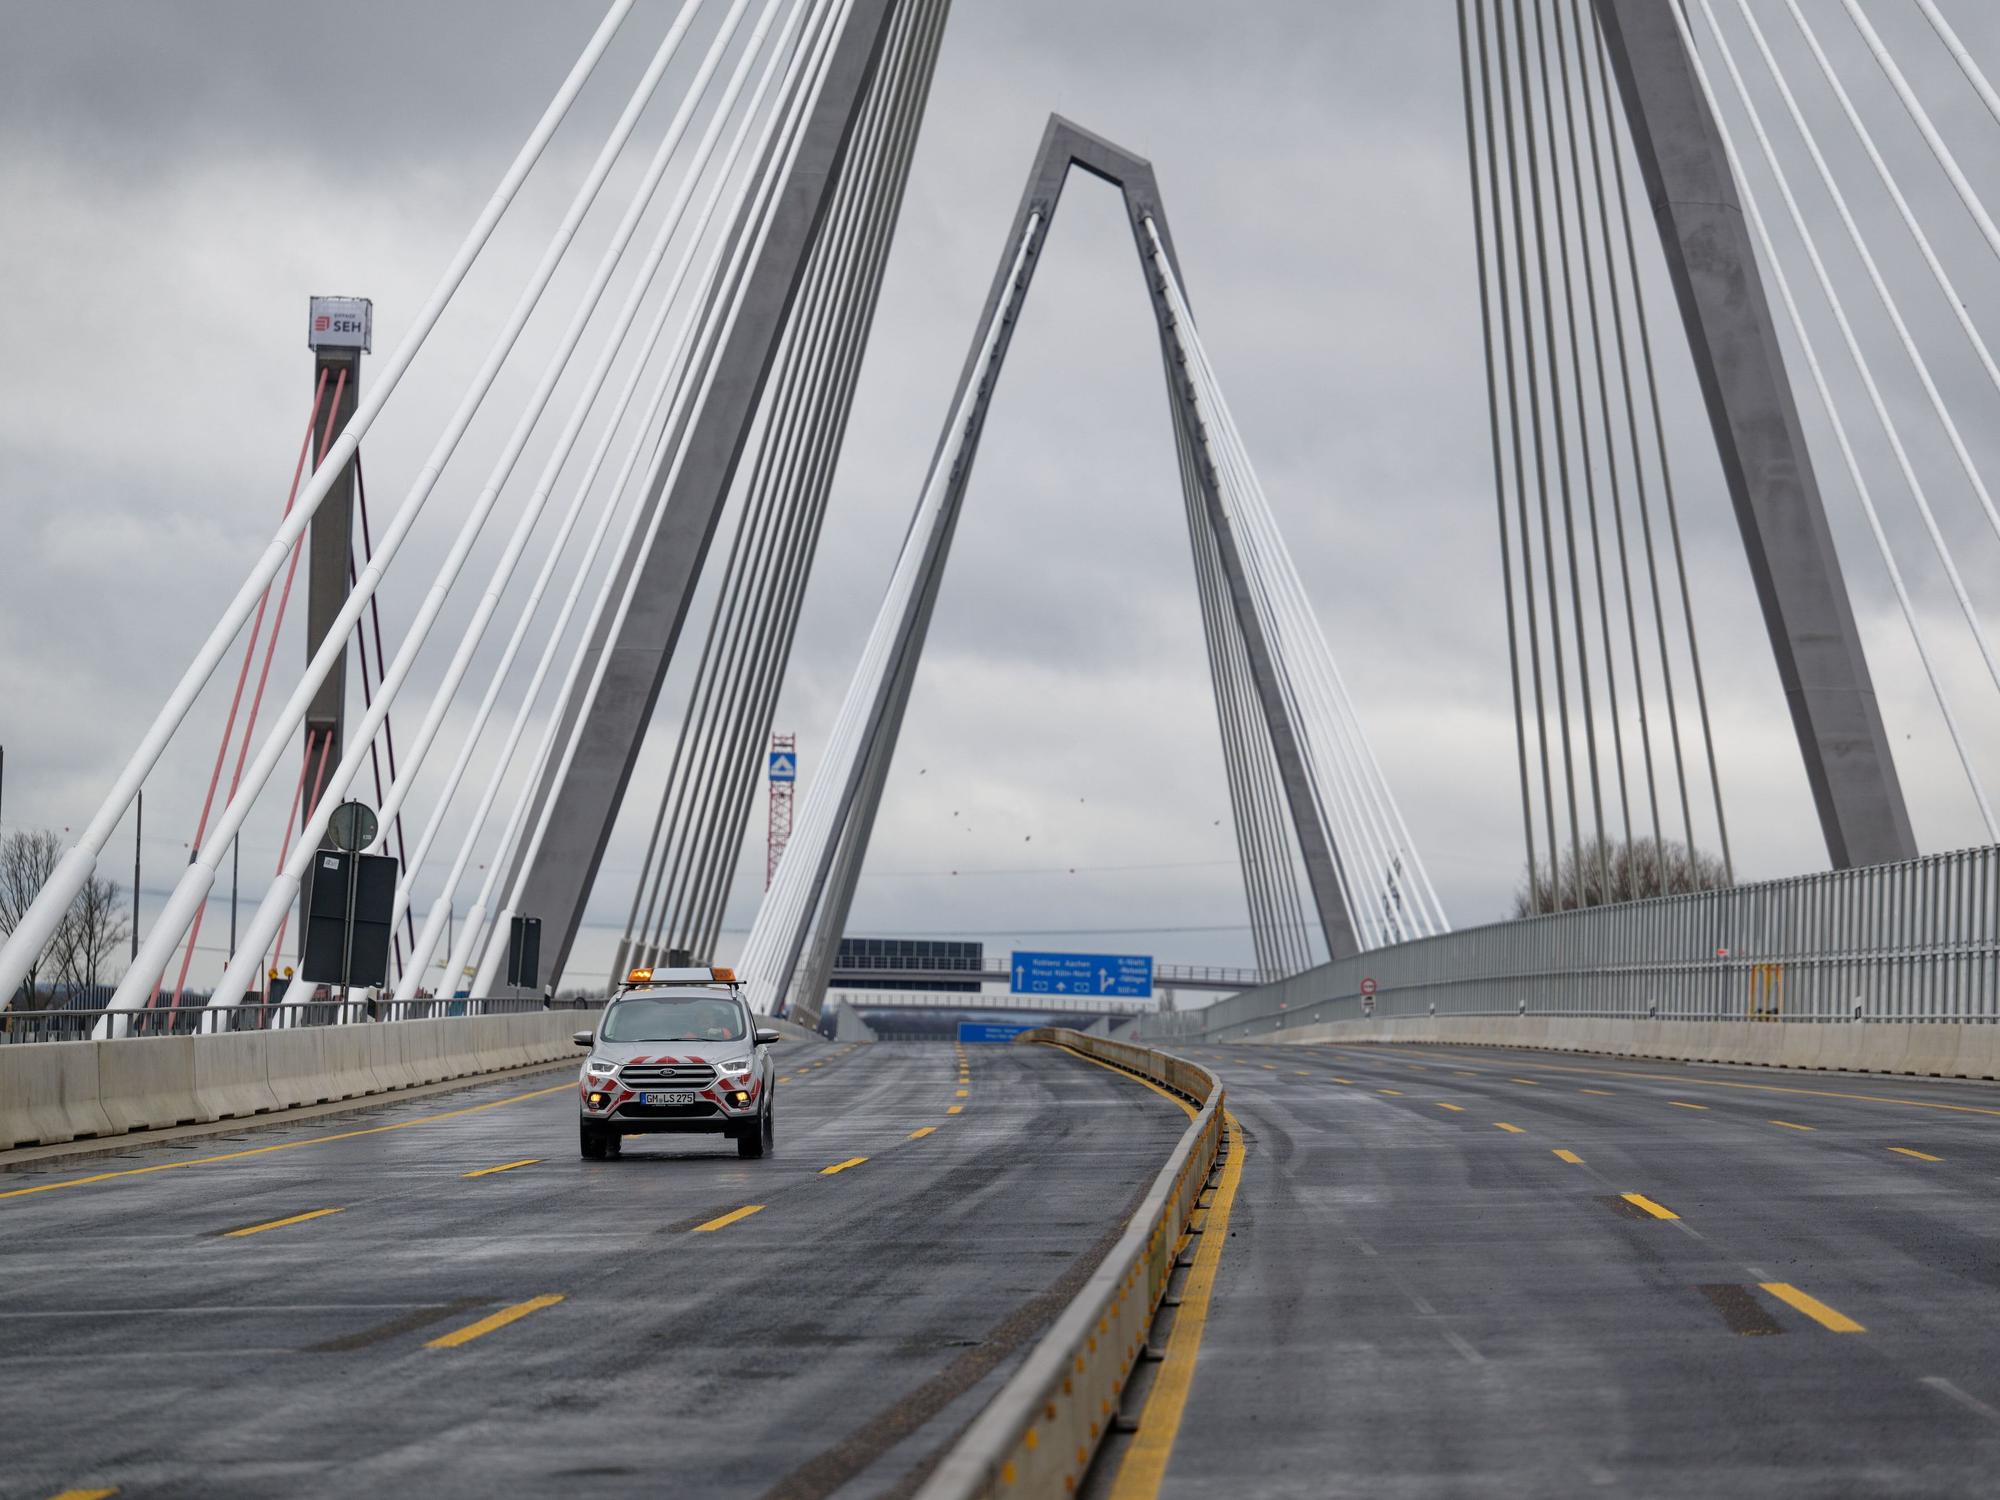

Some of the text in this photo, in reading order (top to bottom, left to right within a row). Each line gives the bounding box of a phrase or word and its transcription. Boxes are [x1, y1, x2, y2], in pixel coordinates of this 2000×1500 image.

[333, 320, 361, 332] SEH
[646, 1094, 693, 1103] GM LS 275
